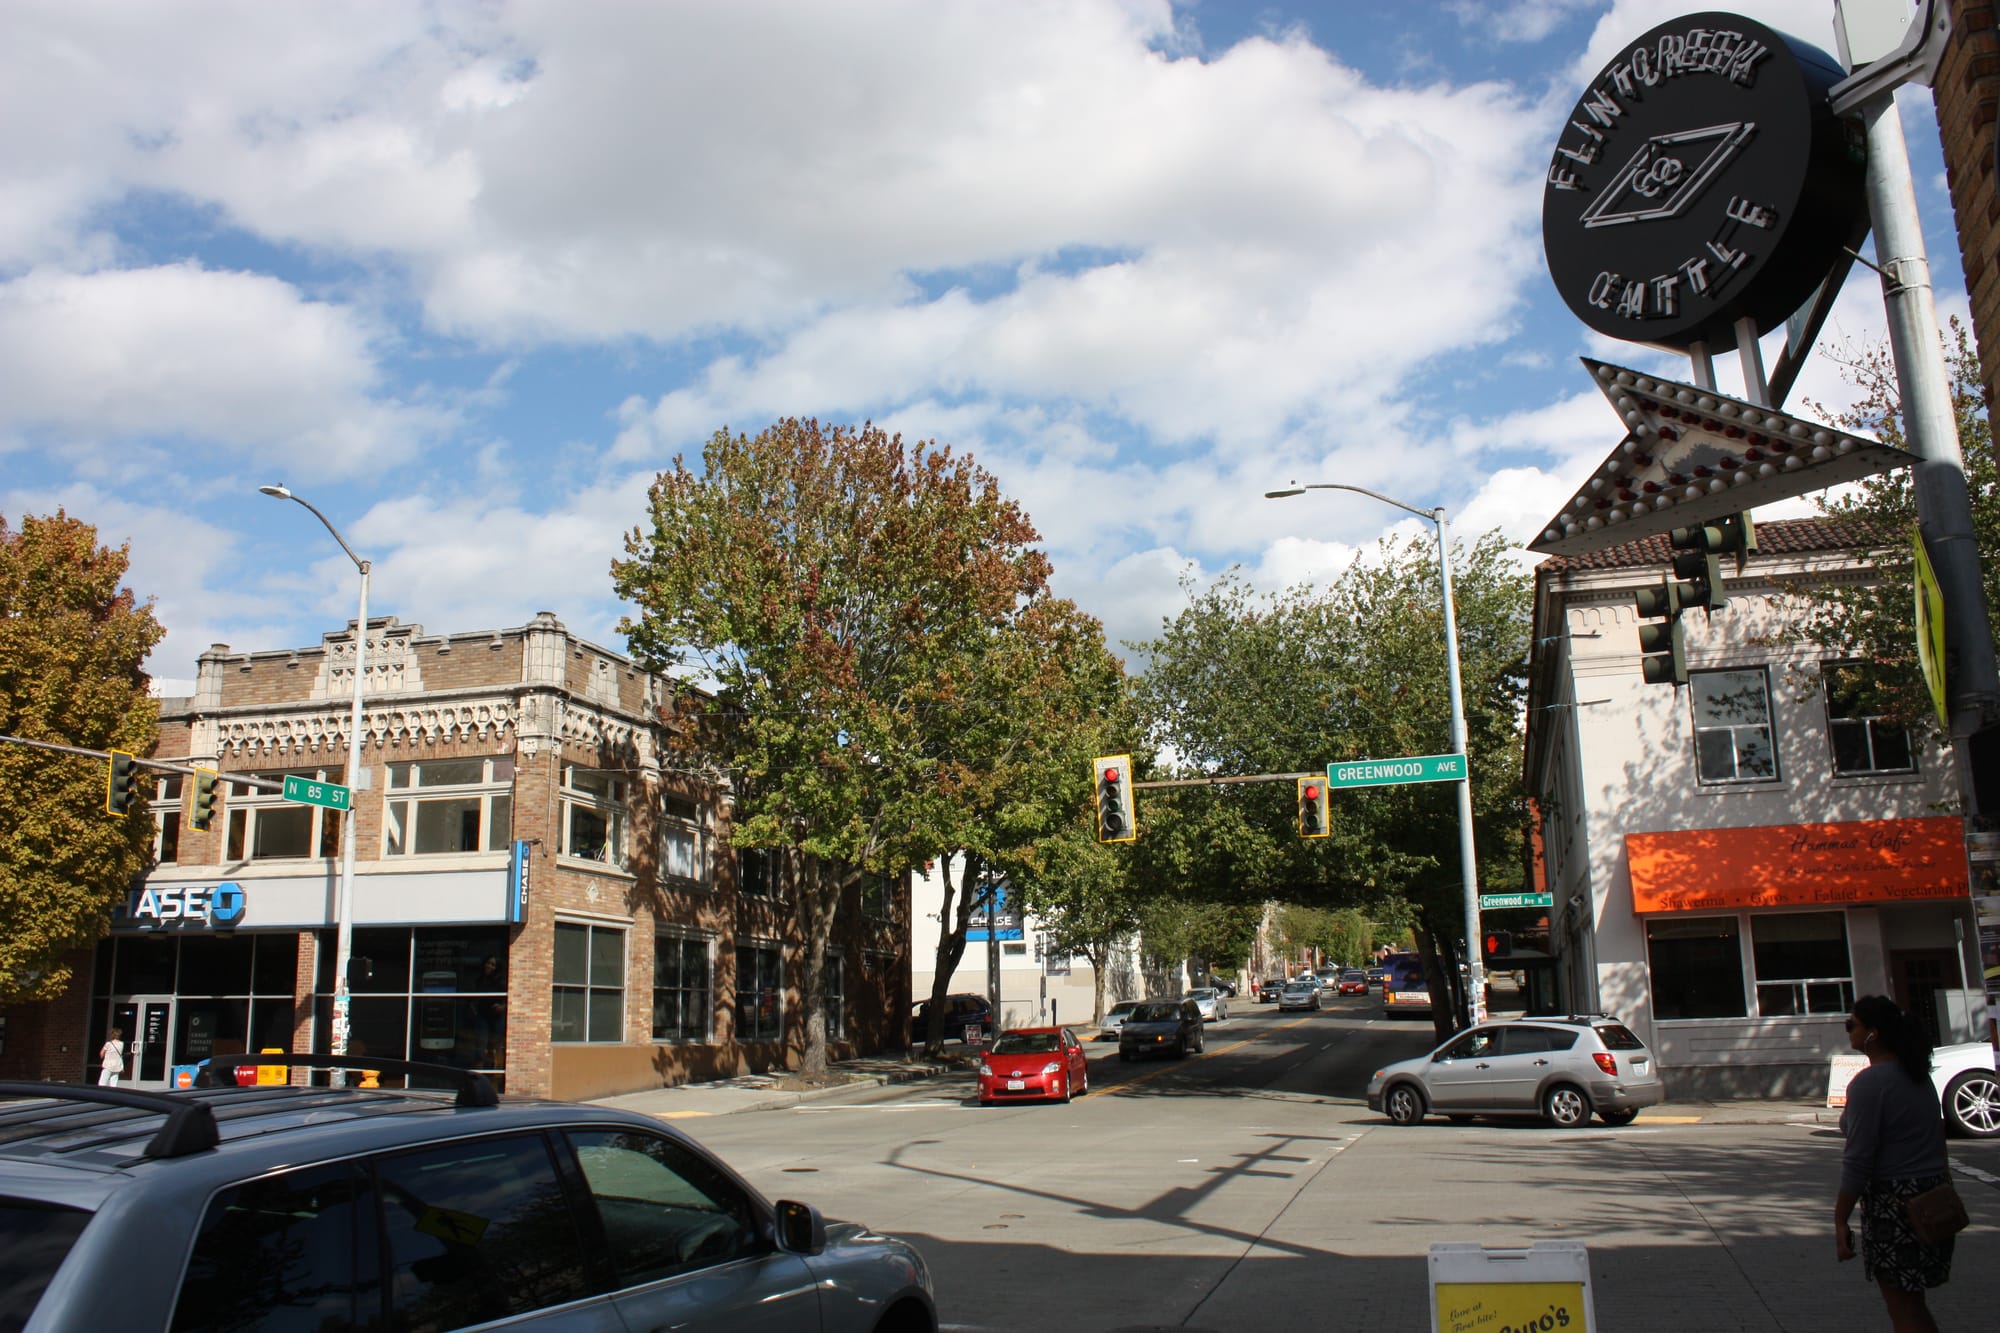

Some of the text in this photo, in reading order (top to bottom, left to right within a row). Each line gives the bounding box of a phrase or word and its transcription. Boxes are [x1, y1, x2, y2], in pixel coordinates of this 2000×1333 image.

[1632, 28, 1767, 86] CREEK
[1588, 195, 1772, 320] CATTLE
[1337, 761, 1457, 781] GREENWOOD AVE
[288, 781, 345, 803] N 85 ST
[520, 859, 529, 904] CHASE
[1883, 883, 1953, 898] Vegetarian
[1483, 896, 1522, 907] Greenwood
[1524, 897, 1535, 905] Ave
[970, 915, 1013, 927] CHSE
